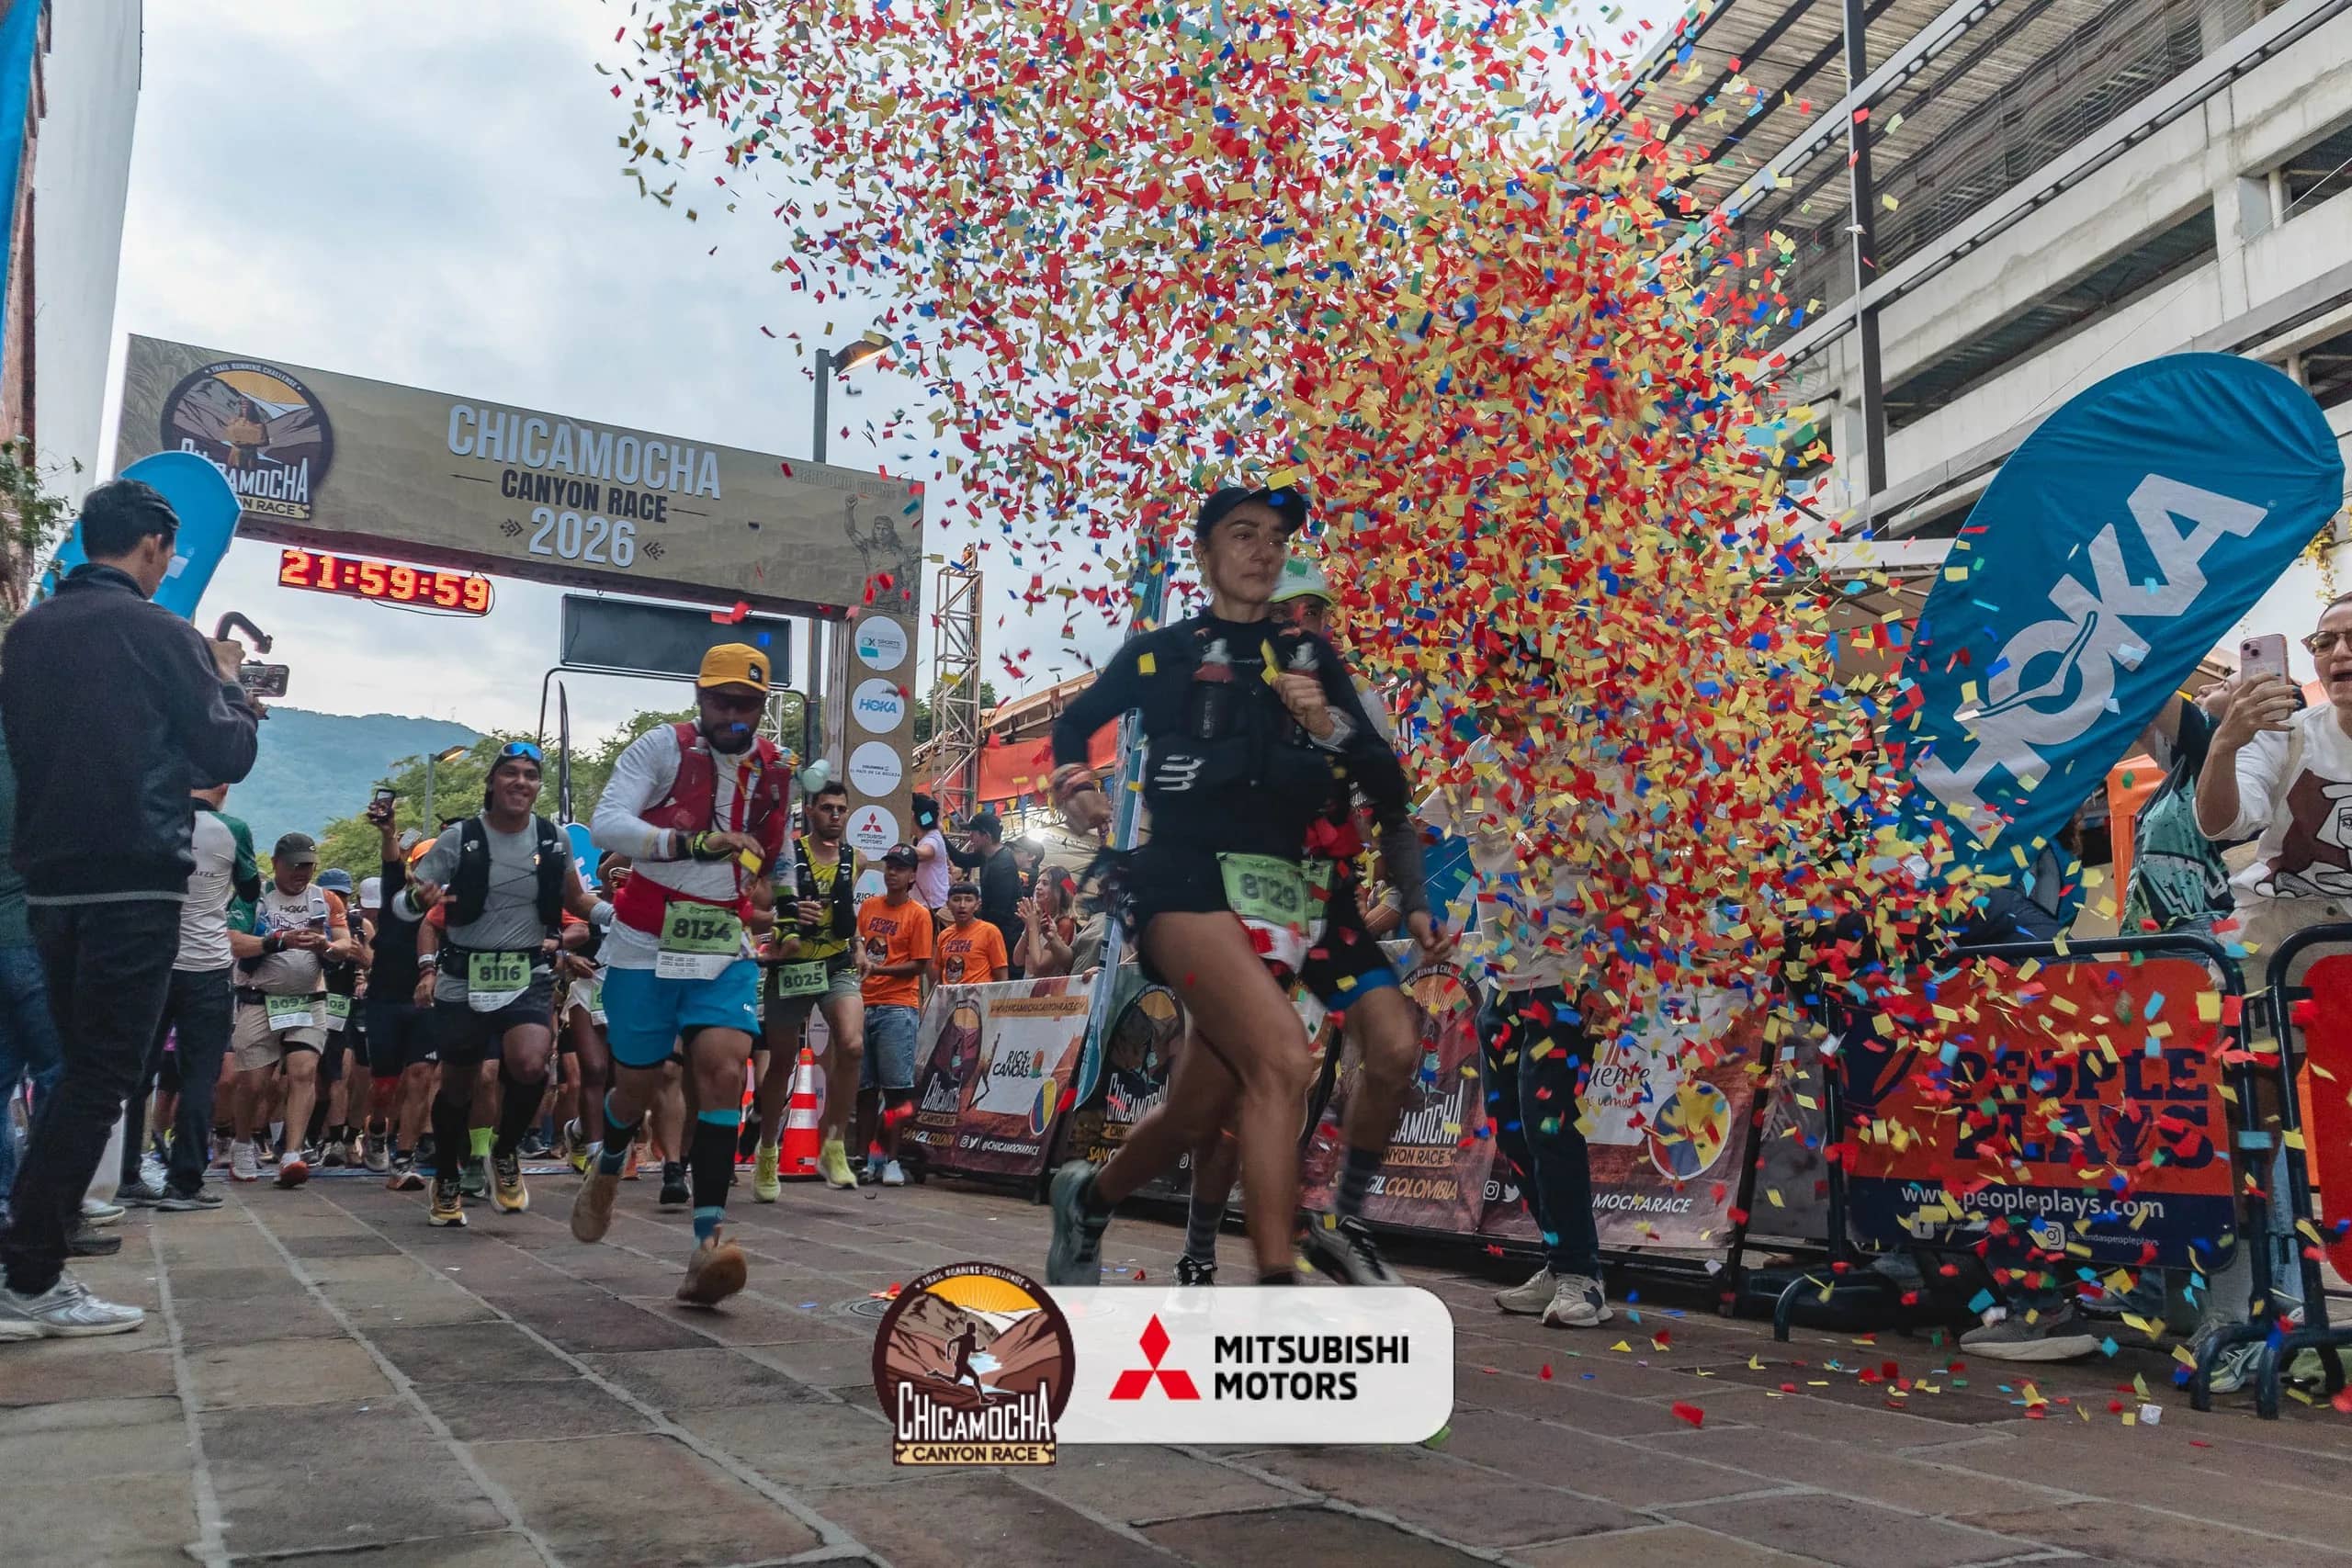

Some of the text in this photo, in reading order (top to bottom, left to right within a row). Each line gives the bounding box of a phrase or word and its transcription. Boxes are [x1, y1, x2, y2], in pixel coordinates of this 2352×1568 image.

[447, 404, 721, 500] CHICAMOCHA
[502, 469, 669, 524] CANYON RACE
[256, 498, 296, 516] RACE
[529, 506, 636, 569] 2026
[280, 549, 489, 611] 21:59:59
[1917, 473, 2269, 842] HOKA
[858, 698, 897, 713] HOKA
[279, 905, 309, 913] HOKA
[672, 918, 733, 942] 8134
[868, 923, 898, 936] PLAYS
[872, 917, 899, 928] PEOPLE
[480, 965, 521, 981] 8116
[784, 972, 824, 988] 8025
[1006, 1050, 1028, 1064] RIOS
[992, 1062, 1031, 1078] CANOAS
[1417, 1150, 1444, 1165] RACE
[1385, 1177, 1459, 1201] COLOMBIA
